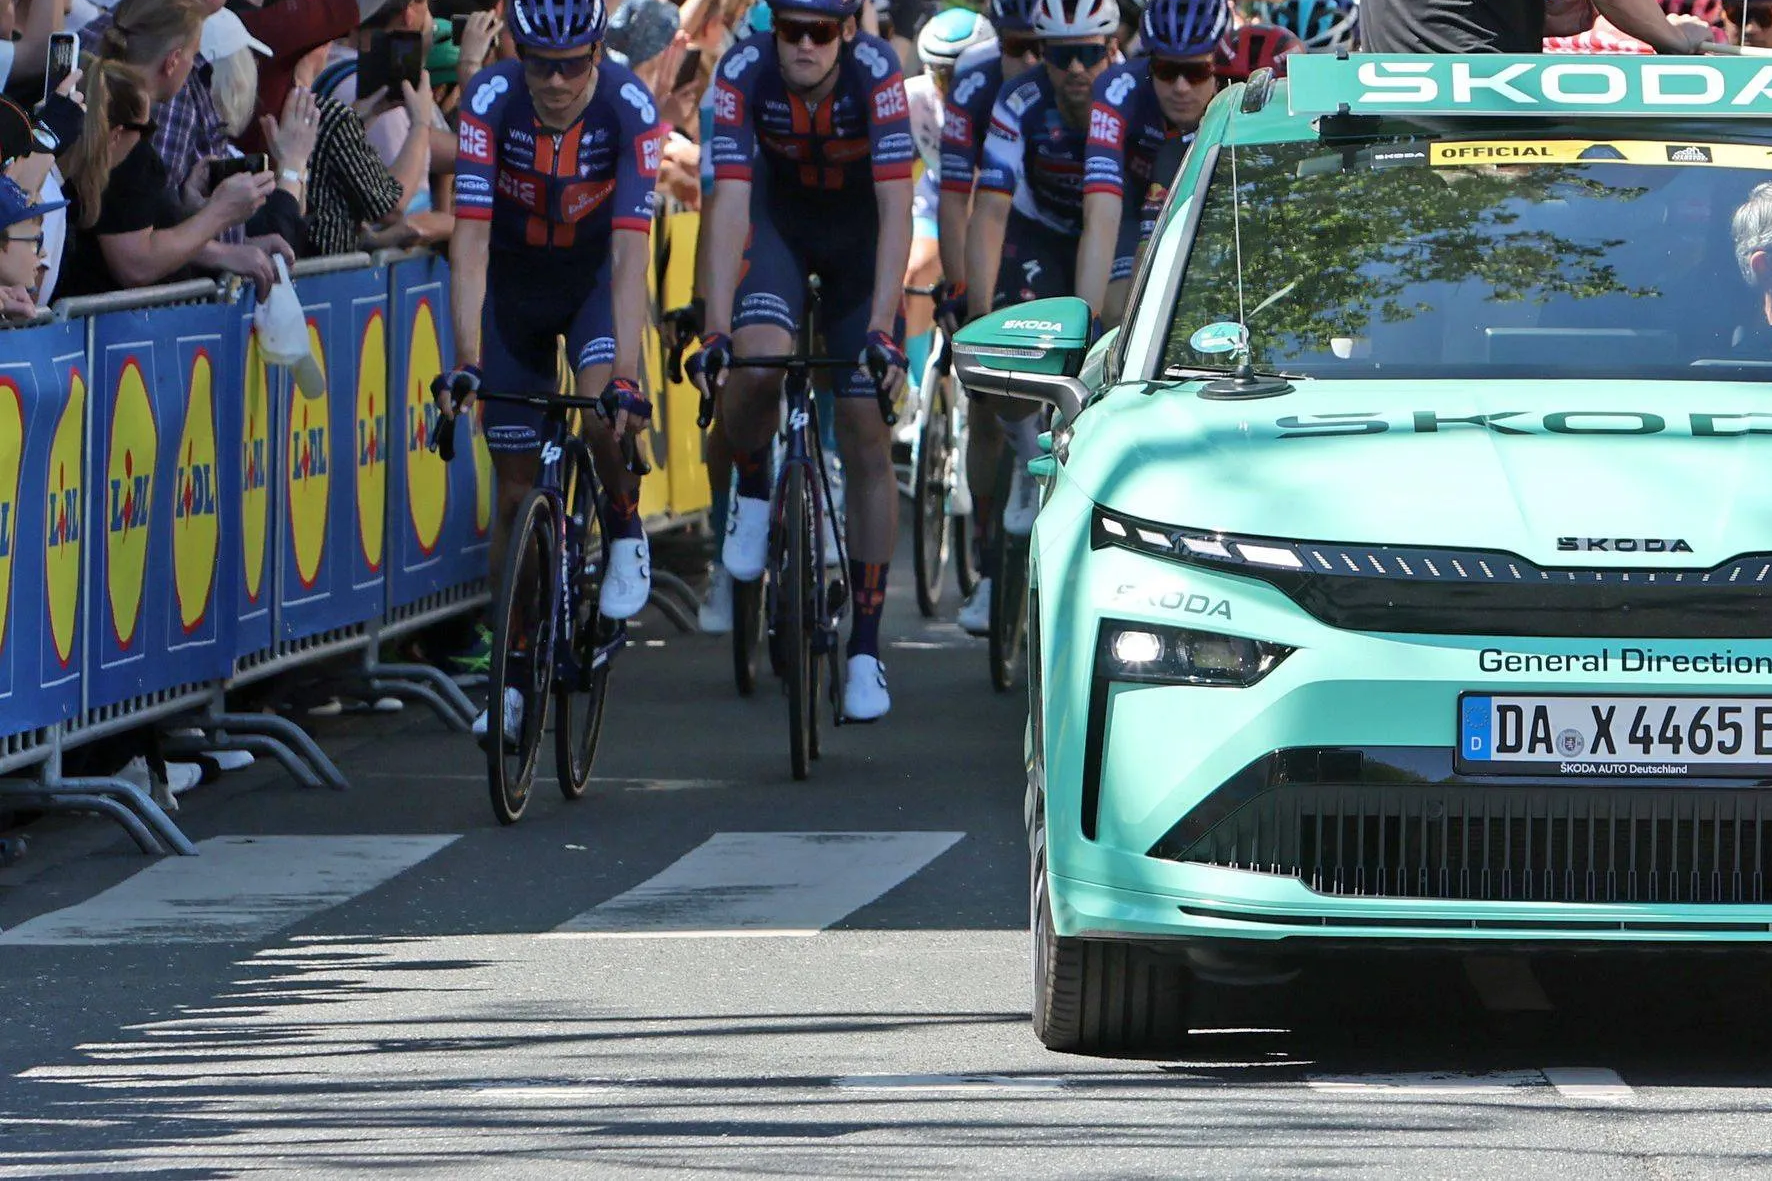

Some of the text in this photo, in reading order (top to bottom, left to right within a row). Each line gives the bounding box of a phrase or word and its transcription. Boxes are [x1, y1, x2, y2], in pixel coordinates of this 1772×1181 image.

[1441, 146, 1554, 159] OFFICIAL
[1479, 648, 1609, 672] General
[1496, 704, 1554, 755] DA
[1570, 705, 1617, 755] X
[1471, 737, 1482, 751] D
[1560, 761, 1688, 775] ŠKODA AUTO Deutschland
